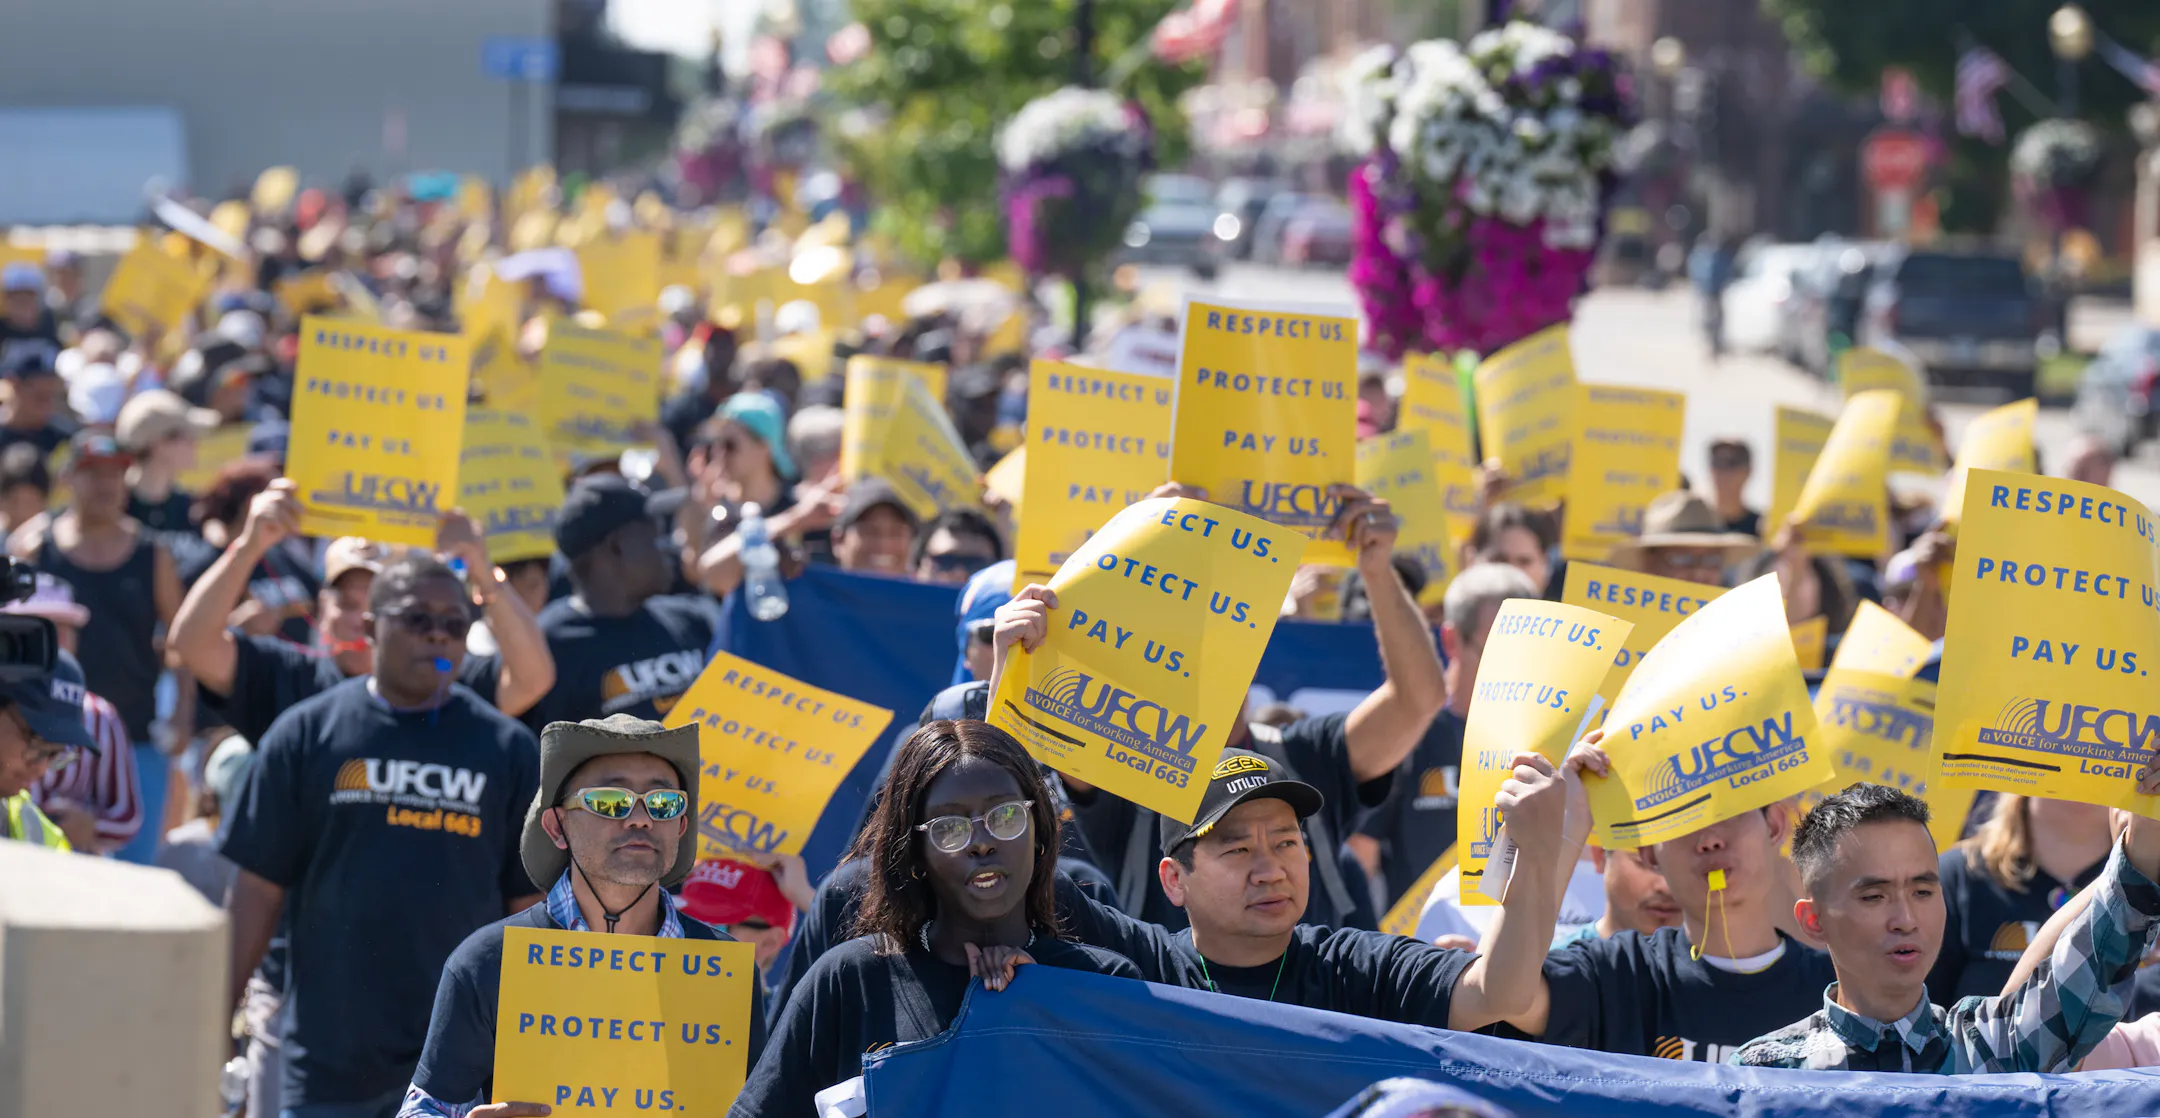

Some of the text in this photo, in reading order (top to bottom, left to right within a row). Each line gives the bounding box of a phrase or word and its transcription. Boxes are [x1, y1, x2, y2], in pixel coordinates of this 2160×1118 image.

[1207, 311, 1348, 341] RESPECT US.
[316, 330, 407, 357] RESPECT
[307, 377, 406, 406] PROTECT
[1048, 374, 1171, 406] RESPECT U
[1197, 367, 1350, 401] PROTECT US.
[328, 429, 373, 447] PAY
[1042, 426, 1170, 459] PROTECT U
[1223, 430, 1327, 458] PAY US.
[1068, 483, 1114, 505] PAY
[1242, 479, 1344, 516] UFCW
[1991, 485, 2159, 548] RESPECT US.
[1230, 528, 1279, 563] US.
[1097, 553, 1257, 629] OTECT US.
[1976, 558, 2160, 612] PROTECT US
[1067, 609, 1191, 678] PAY US.
[1497, 615, 1602, 650] RESPECT US.
[2011, 636, 2147, 676] PAY US.
[723, 669, 866, 731] RESPECT US.
[1074, 672, 1207, 755] UFCW
[1478, 681, 1570, 713] PROTECT US.
[1630, 685, 1748, 741] PAY US.
[690, 707, 839, 769] PROTECT US.
[1035, 693, 1072, 719] VOICE
[1073, 712, 1091, 727] for
[1093, 722, 1141, 750] working
[1144, 743, 1192, 769] America
[1669, 711, 1792, 780] UFCW
[1982, 731, 2153, 762] a VOICE for working Amer
[1105, 743, 1189, 788] Local 663
[1478, 750, 1514, 770] PAY US
[1646, 784, 1683, 804] VOICE
[1705, 761, 1754, 781] working
[1755, 741, 1801, 763] America
[1729, 751, 1809, 789] Local 663
[2006, 767, 2037, 777] deliveries
[2080, 759, 2131, 779] Local
[365, 758, 487, 803] UFCW
[745, 776, 779, 797] US.
[1226, 776, 1267, 794] UTILITY
[1981, 773, 2012, 782] economic
[386, 804, 442, 830] Local
[528, 943, 733, 978] RESPECT US.
[518, 1012, 732, 1046] PROTECT US.
[555, 1084, 685, 1111] PAY US.
